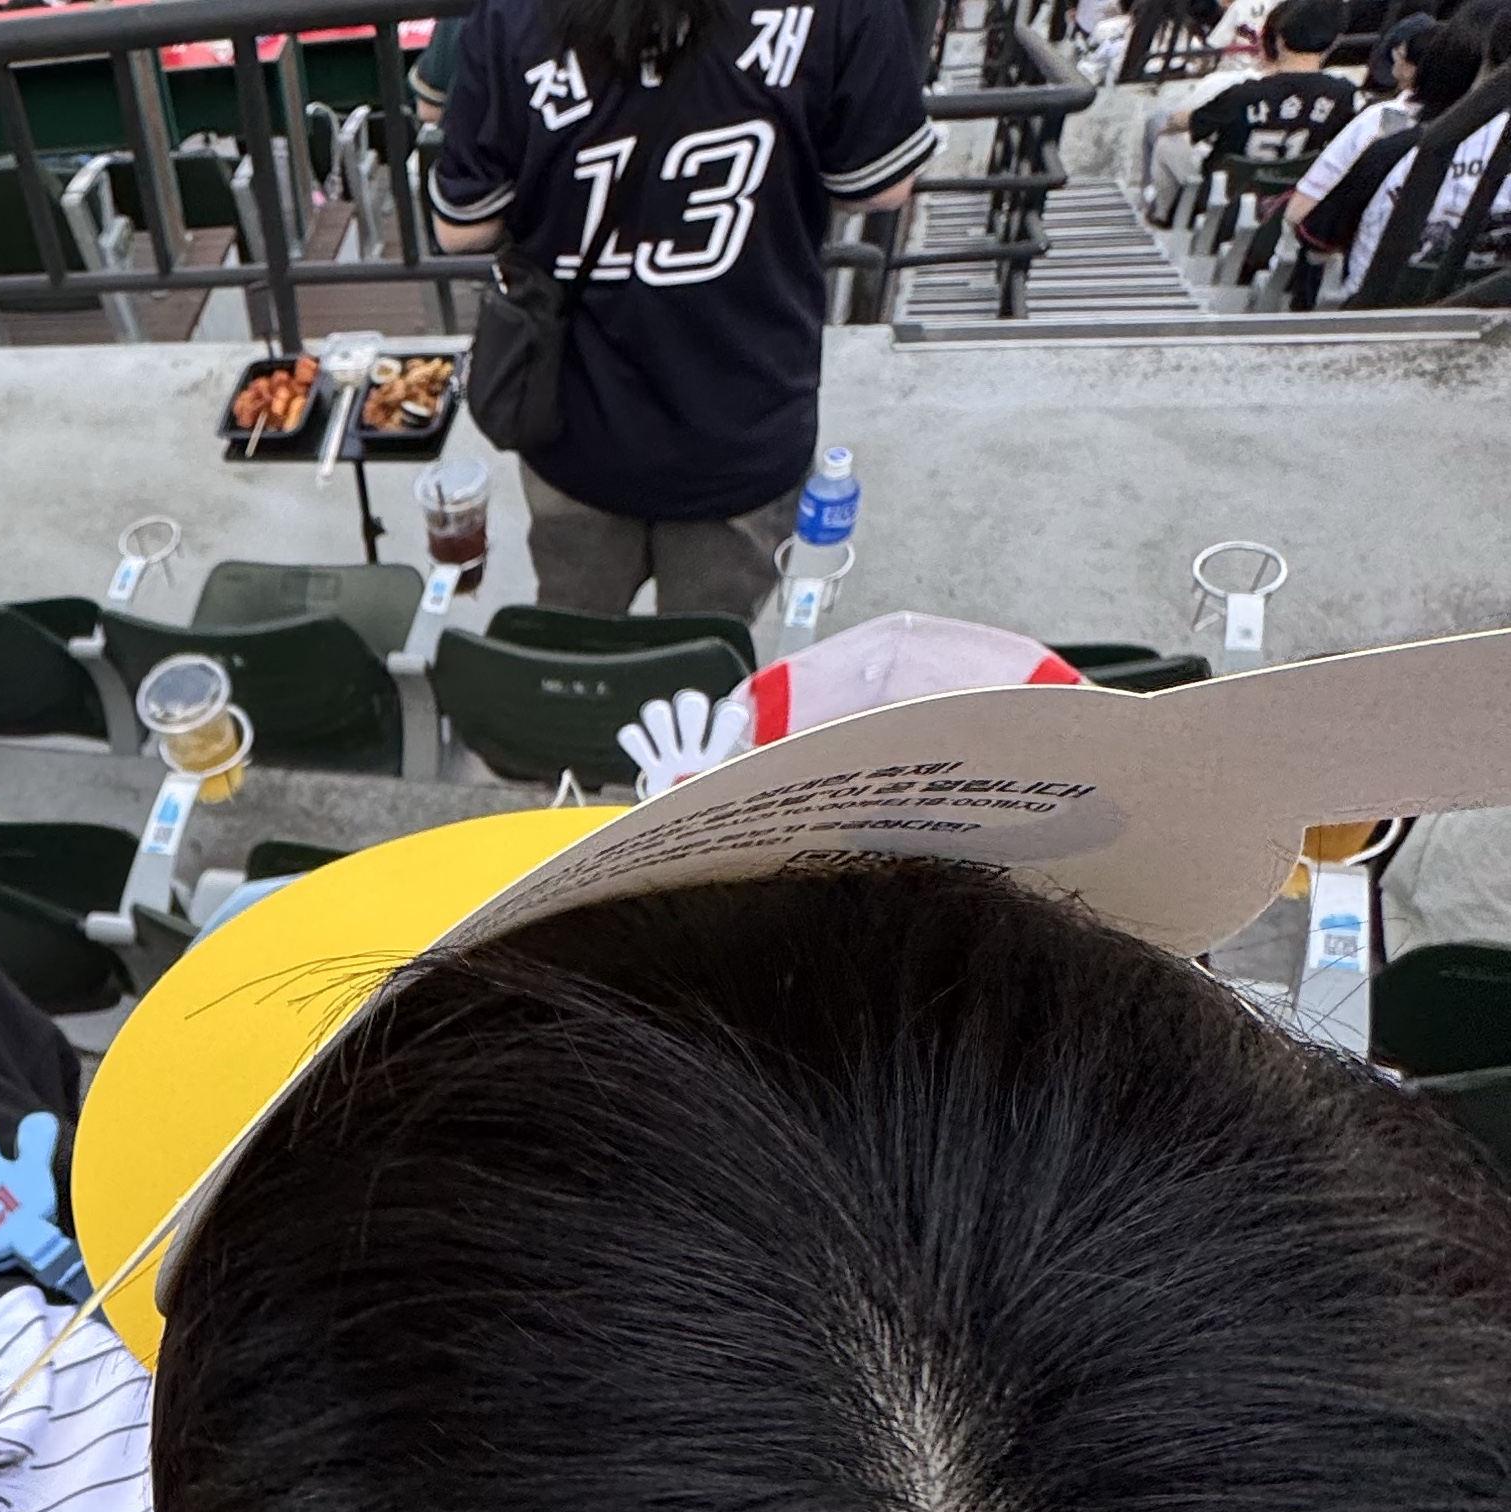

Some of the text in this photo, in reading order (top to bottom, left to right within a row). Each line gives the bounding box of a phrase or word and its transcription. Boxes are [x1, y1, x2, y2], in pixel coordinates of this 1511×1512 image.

[524, 5, 815, 132] 전재
[553, 119, 776, 287] 13
[1245, 128, 1310, 161] 51
